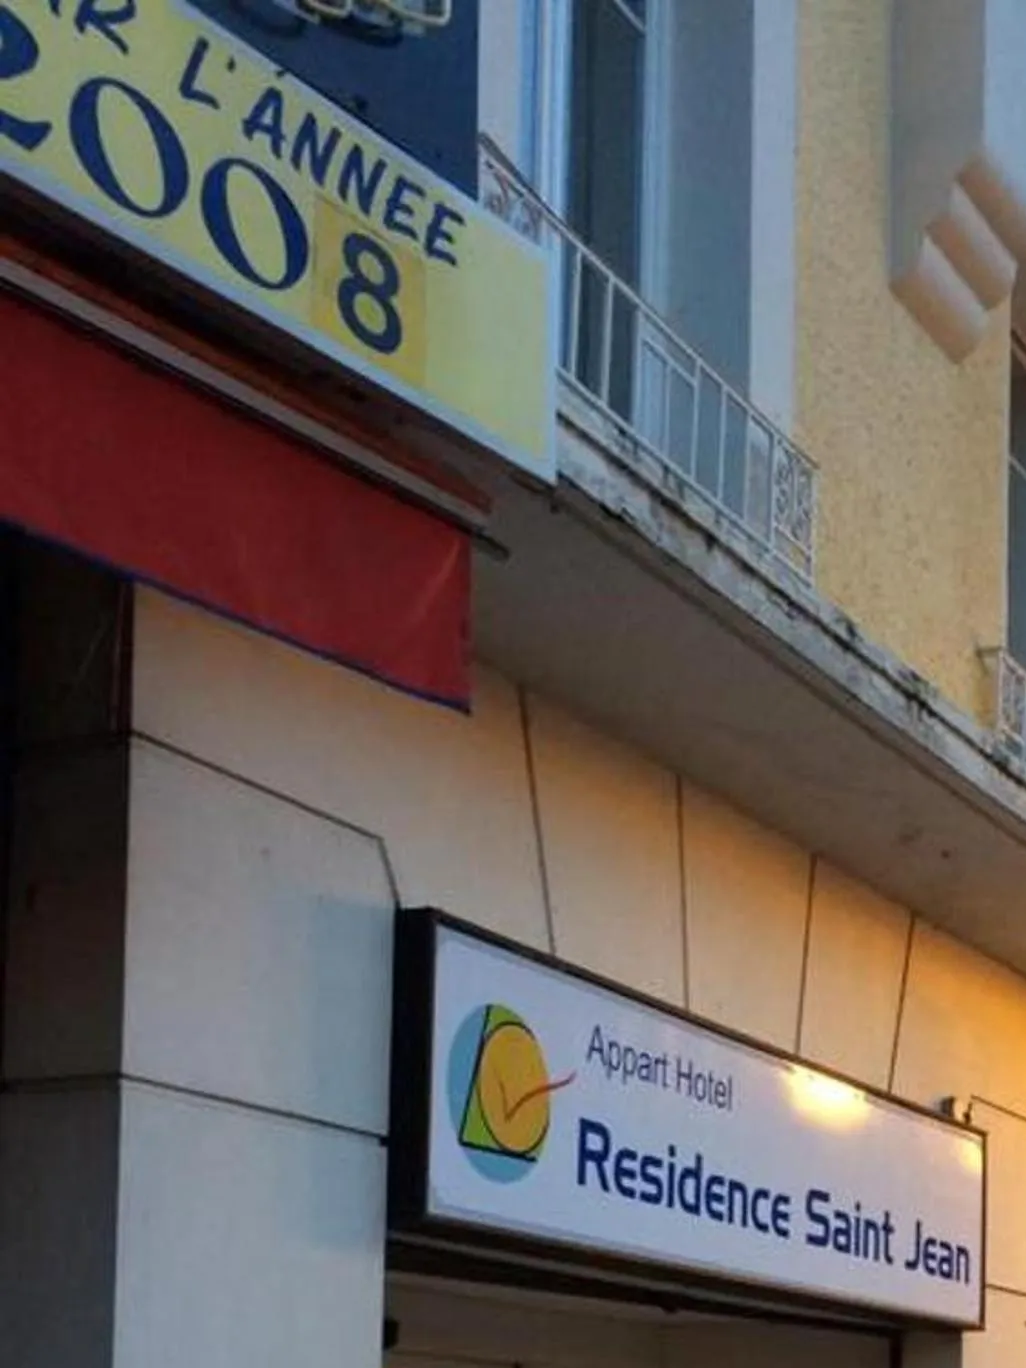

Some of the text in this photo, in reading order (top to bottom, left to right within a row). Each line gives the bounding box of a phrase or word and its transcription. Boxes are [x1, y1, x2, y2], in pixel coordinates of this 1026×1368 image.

[586, 1025, 733, 1112] Appart Hotel
[577, 1118, 970, 1285] Residence Saint Jean
